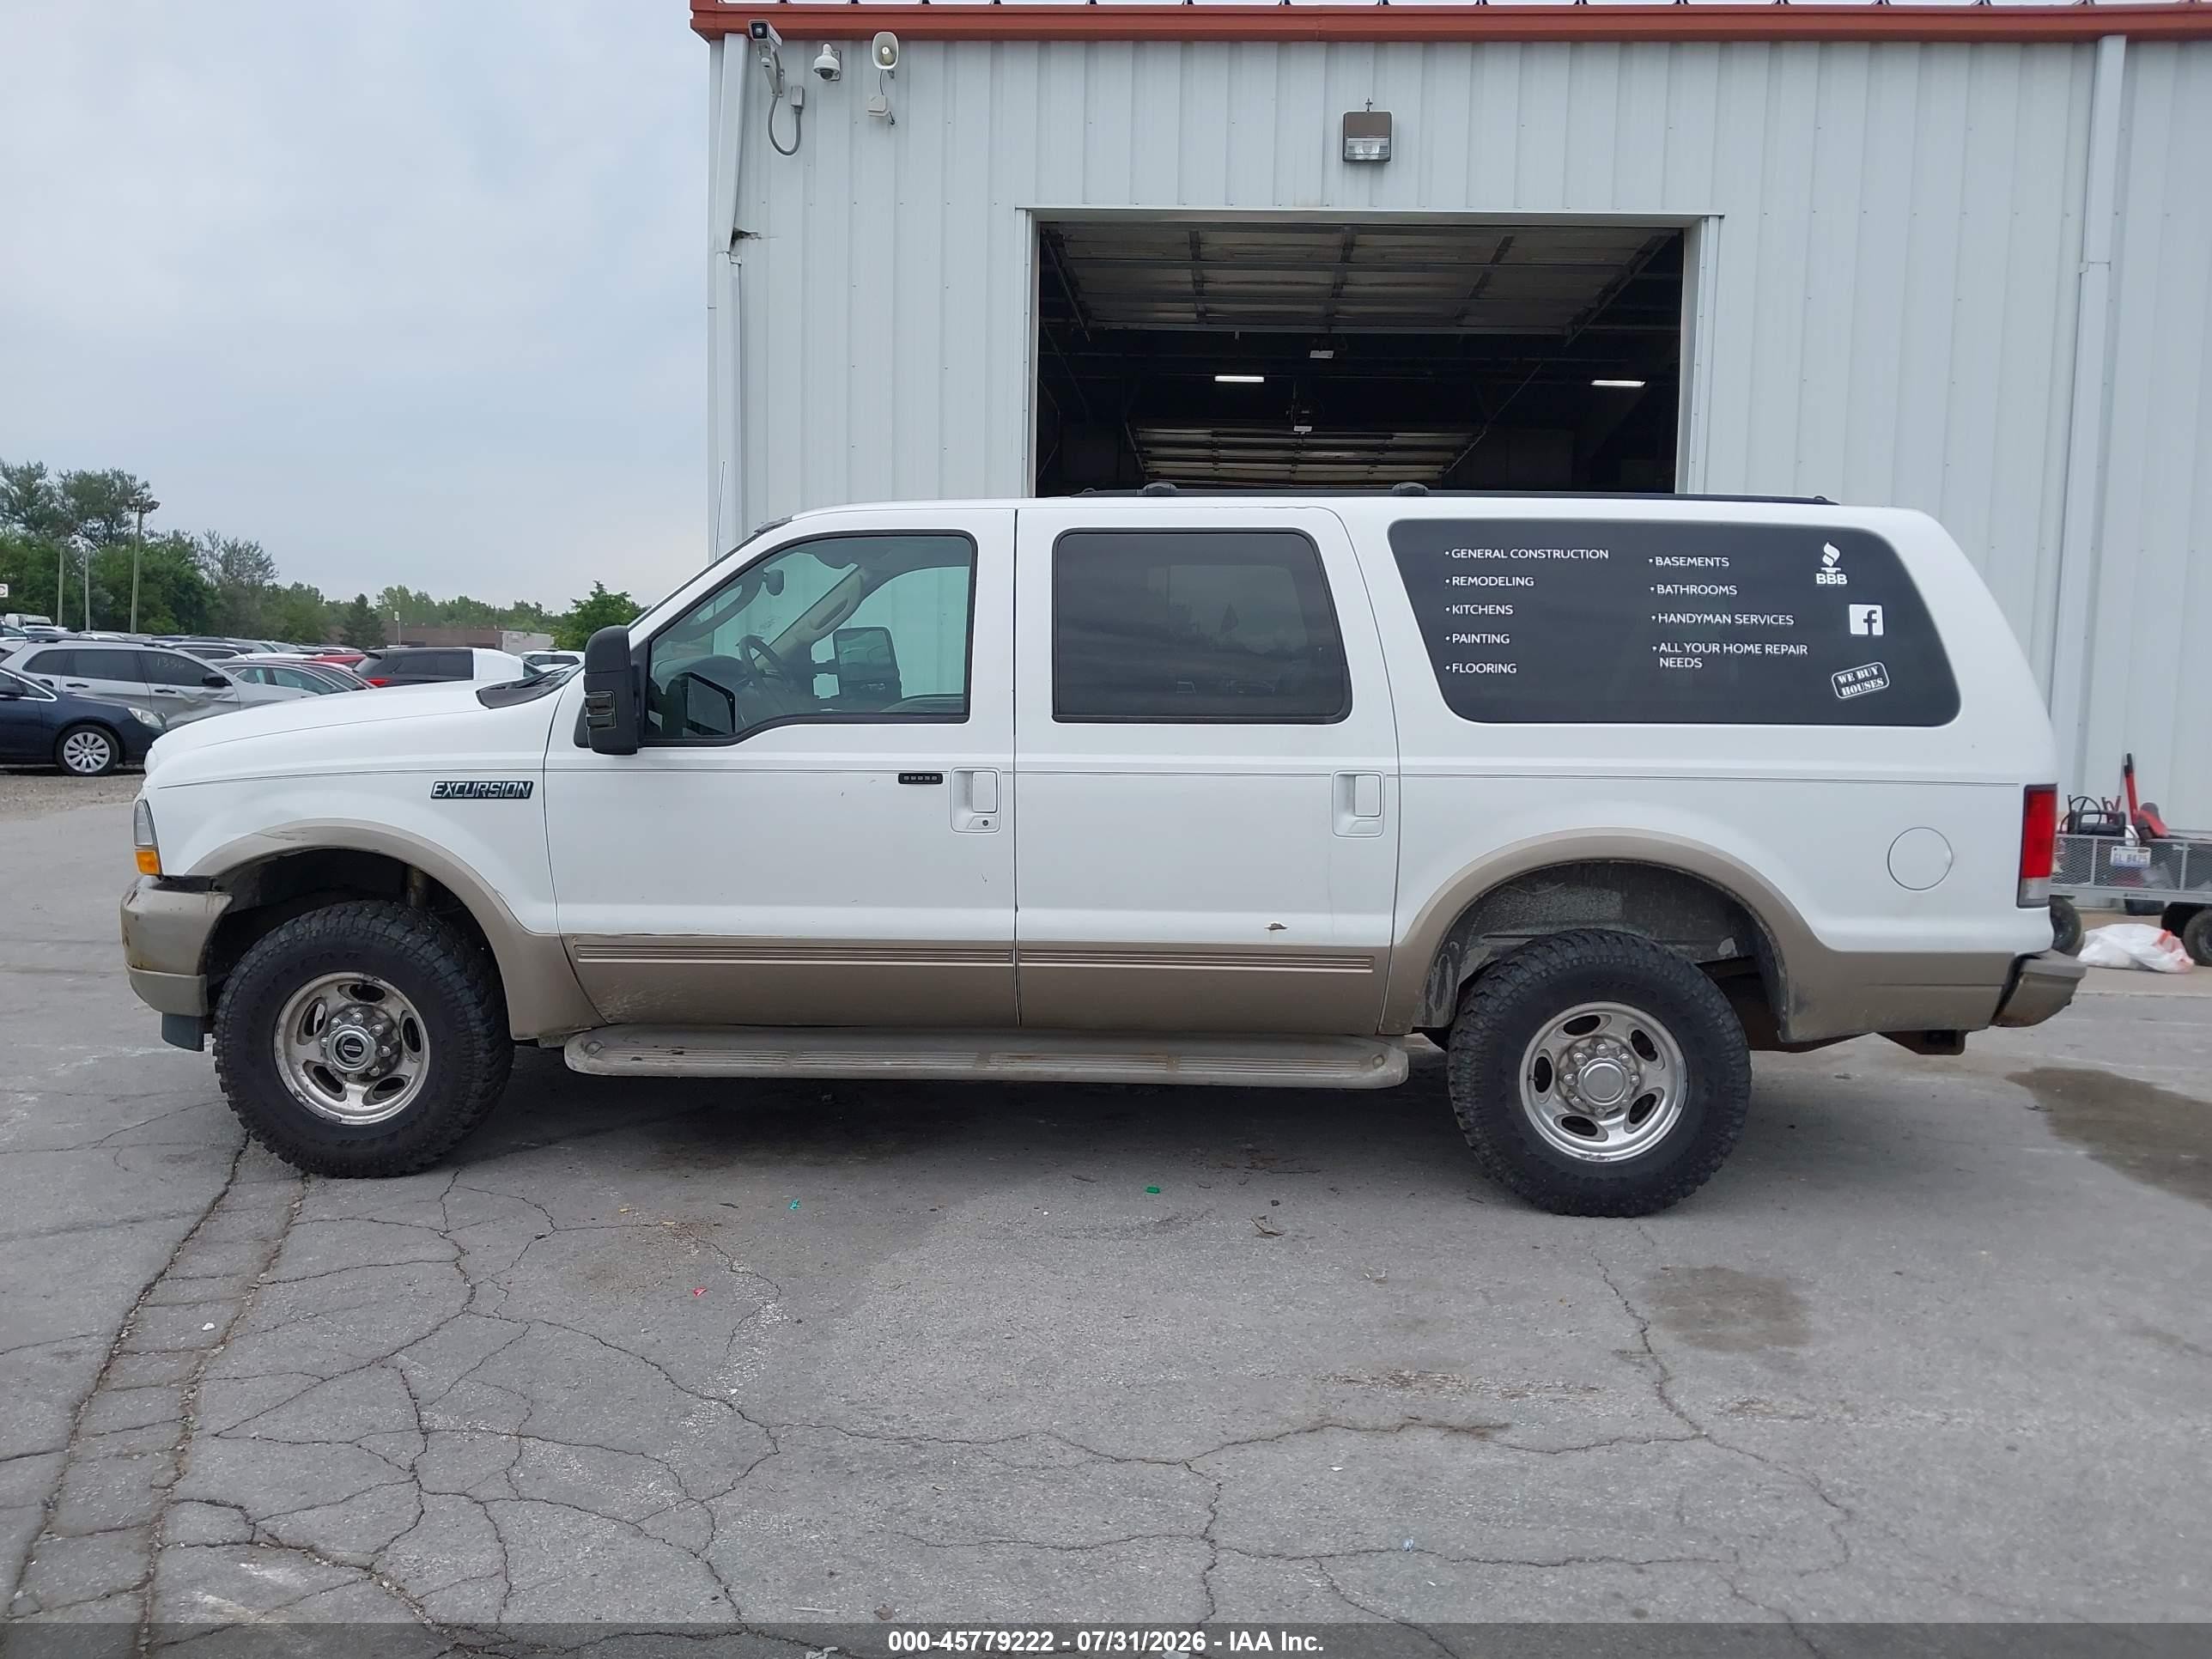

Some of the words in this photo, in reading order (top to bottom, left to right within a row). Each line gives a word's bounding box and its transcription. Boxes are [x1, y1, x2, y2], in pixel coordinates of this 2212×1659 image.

[1451, 549, 1508, 559] GENERAL
[1510, 549, 1609, 560] CONSTRUCTION
[1655, 556, 1730, 568] BASEMENTS
[1452, 576, 1534, 586] REMODELING
[1815, 573, 1848, 585] BBB
[1656, 584, 1738, 595] BATHROOMS
[1452, 605, 1514, 615] KITCHENS
[1658, 613, 1732, 624] HANDYMAN
[1734, 614, 1795, 625] SERVICES
[1452, 633, 1510, 644] PAINTING
[1659, 642, 1683, 653] ALL
[1684, 642, 1721, 653] YOUR
[1723, 643, 1763, 654] HOME
[1765, 644, 1808, 655] REPAIR
[1659, 657, 1703, 668] NEEDS
[1452, 663, 1517, 674] FLOORING
[1837, 671, 1856, 684] WE
[1856, 665, 1880, 679] BUY
[1841, 678, 1885, 696] HOUSES
[431, 781, 532, 798] EXCURSION
